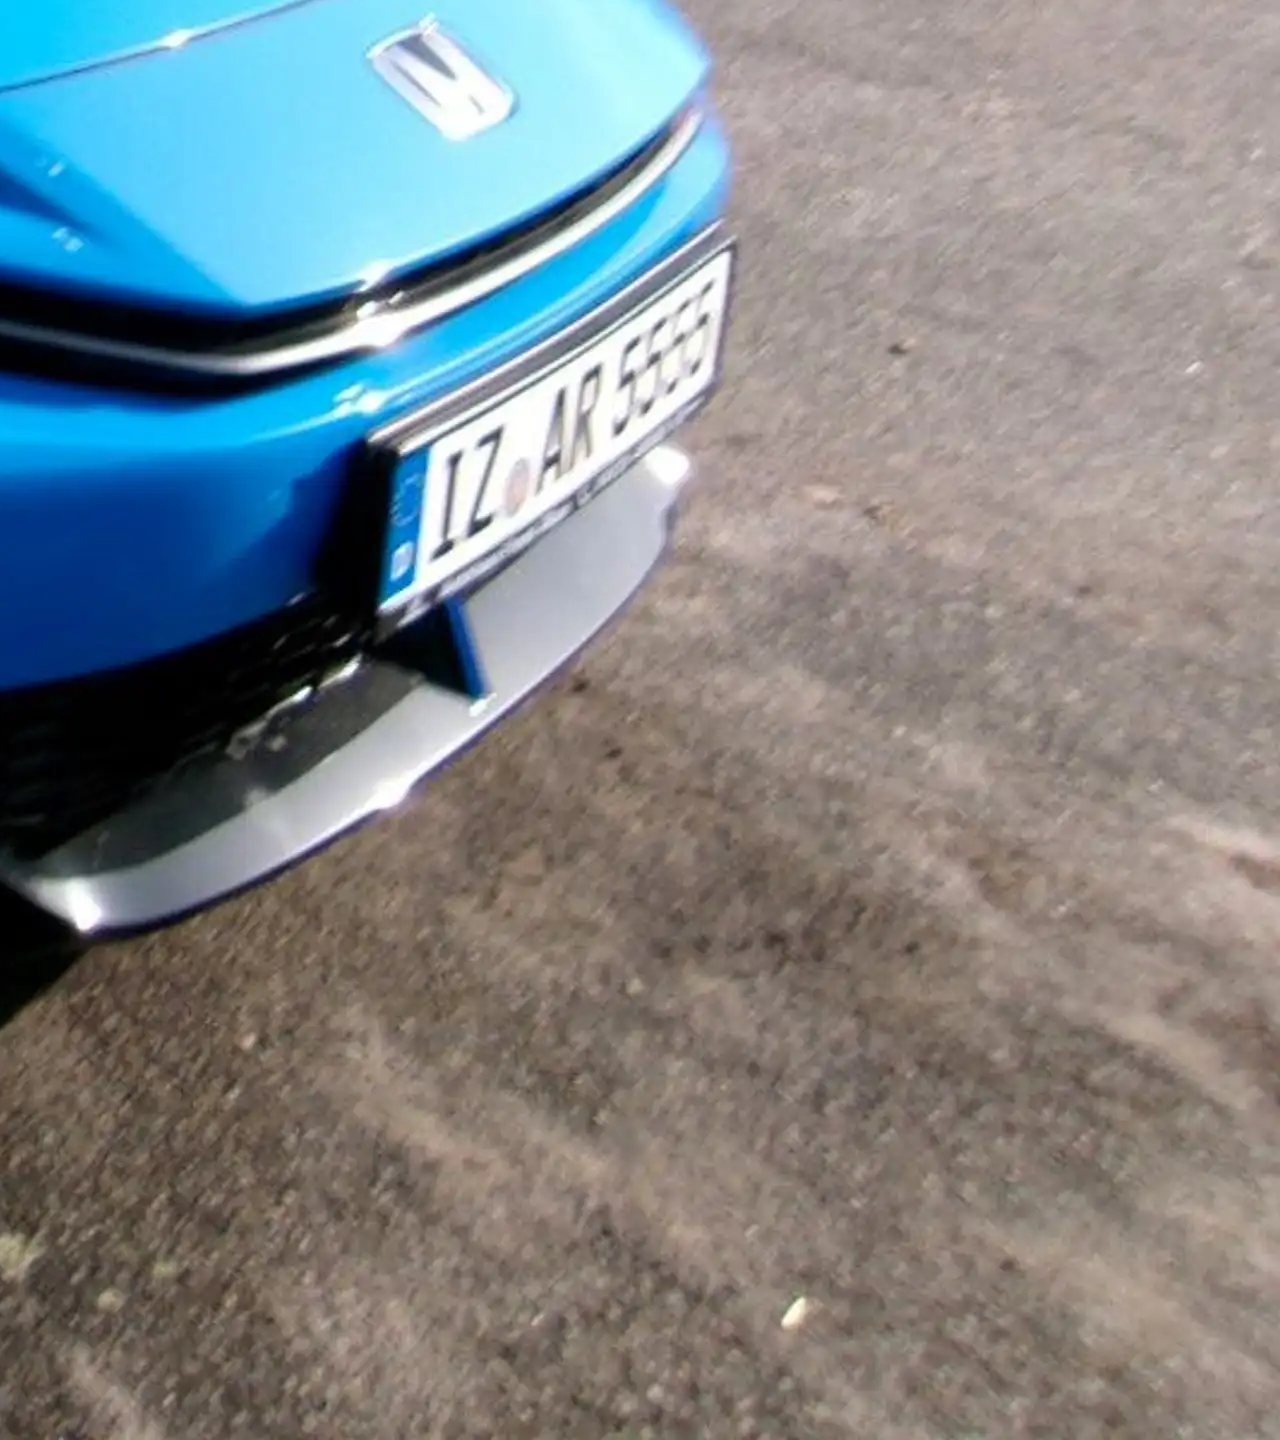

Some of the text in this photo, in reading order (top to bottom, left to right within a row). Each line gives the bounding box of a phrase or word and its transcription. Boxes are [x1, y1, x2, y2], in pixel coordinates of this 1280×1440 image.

[429, 423, 505, 561] IZ
[534, 362, 604, 496] AR
[612, 278, 716, 438] 5555
